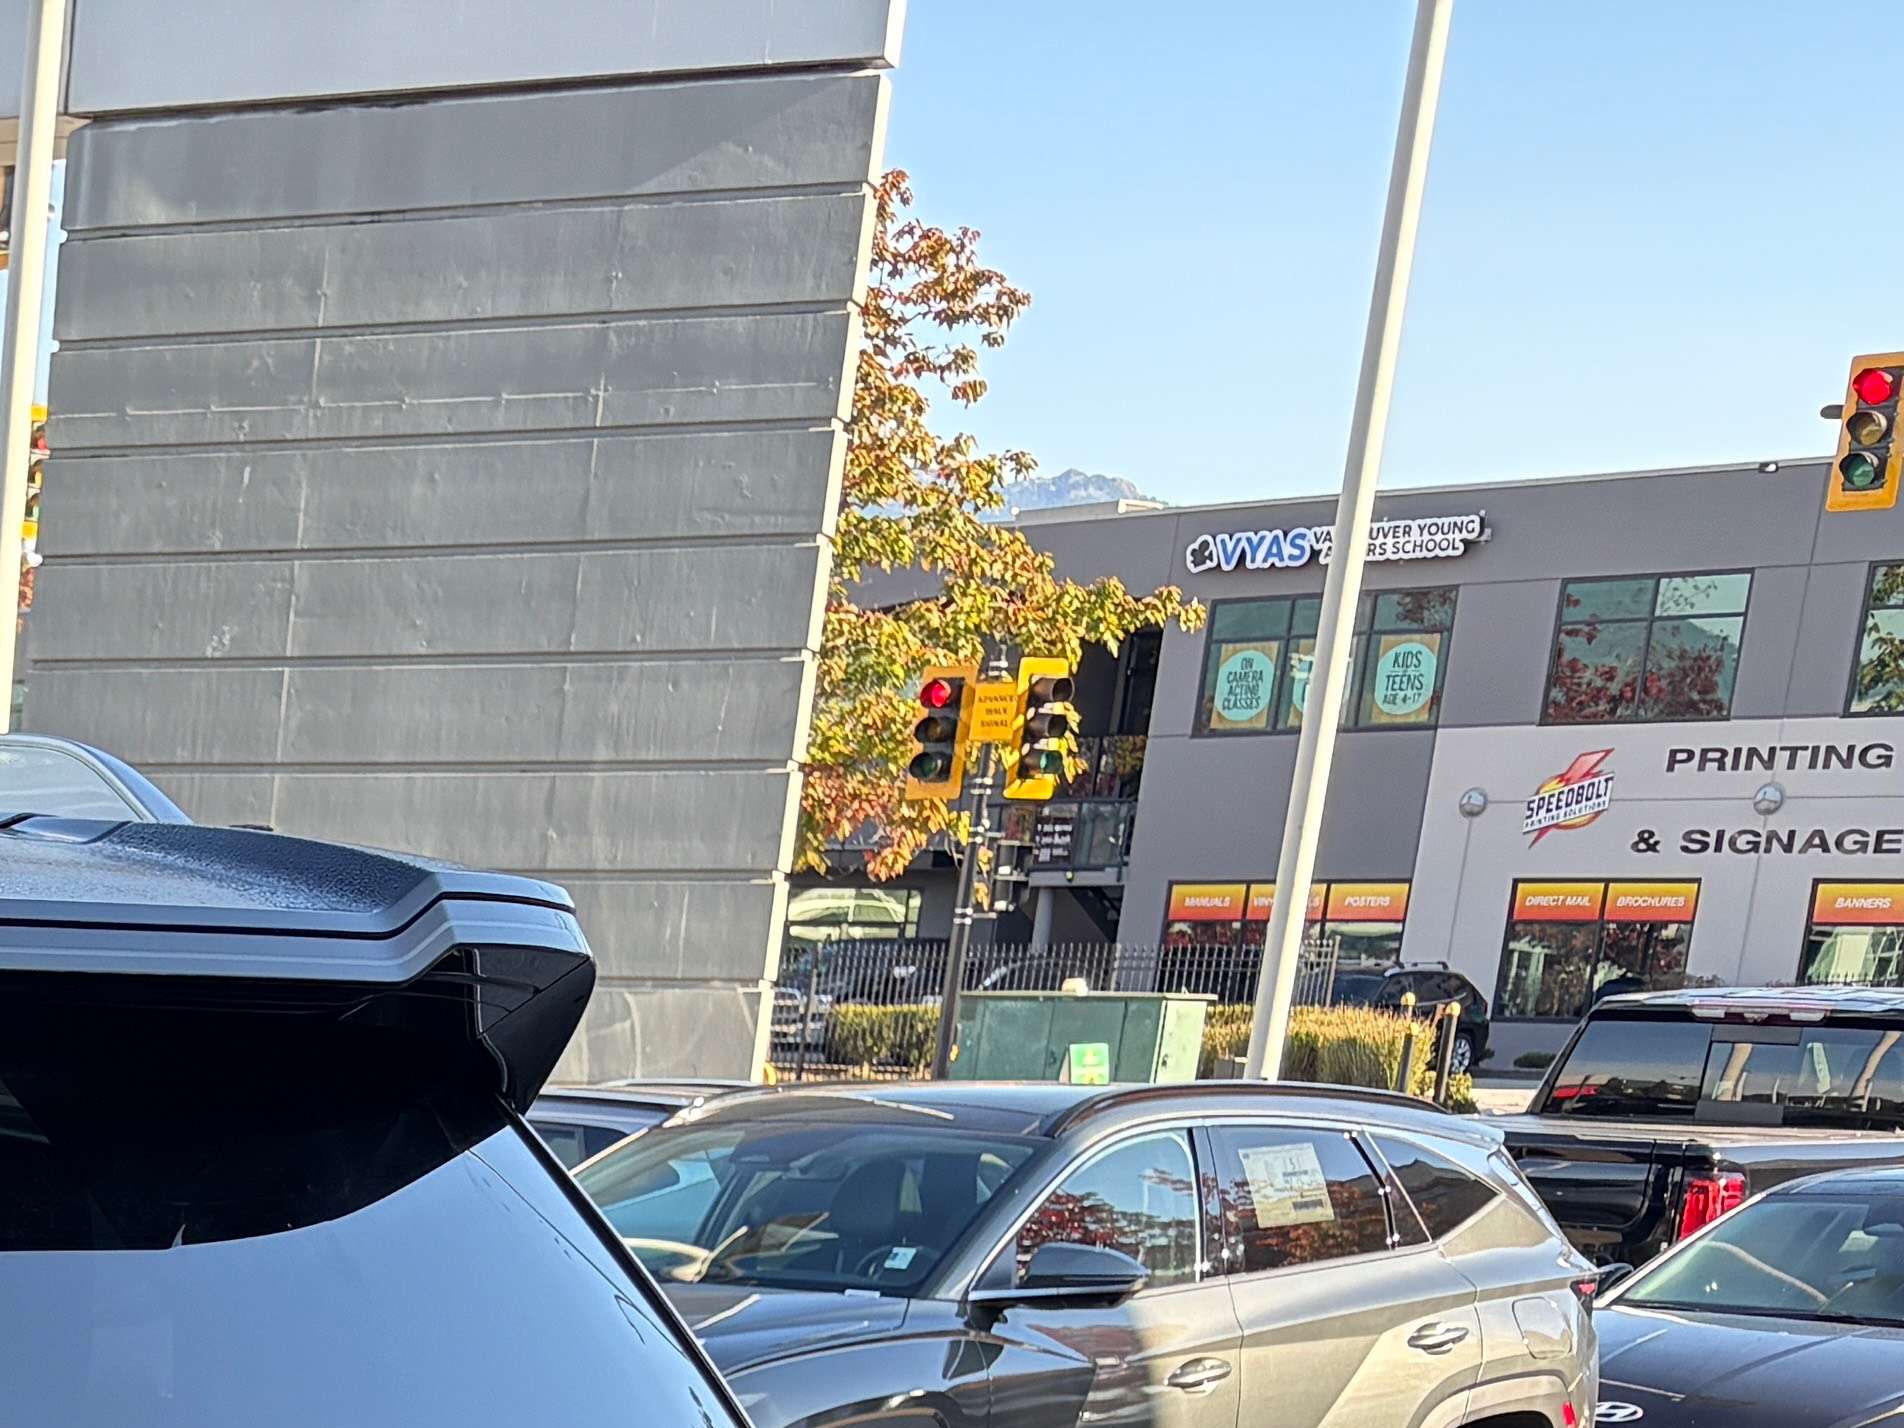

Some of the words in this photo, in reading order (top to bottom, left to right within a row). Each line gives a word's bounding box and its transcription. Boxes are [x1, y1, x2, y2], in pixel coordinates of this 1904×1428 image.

[1313, 523, 1412, 545] VAUVER
[1417, 519, 1476, 537] YOUNG
[1220, 530, 1308, 566] VYAS
[1391, 537, 1460, 555] SCHOOL
[1392, 650, 1423, 669] KIDS
[1226, 669, 1264, 684] CAMERA
[1385, 673, 1424, 692] TEENS
[1227, 683, 1260, 697] ACTING
[1222, 696, 1261, 710] CLASSES
[1665, 743, 1895, 772] PRINTING
[1524, 776, 1615, 820] SPEEDBOLT
[1630, 829, 1661, 853] &
[1679, 829, 1904, 855] SIGNAGE
[1184, 896, 1231, 907] MANUALS
[1344, 896, 1391, 907] POSTERS
[1525, 896, 1564, 907] DIRECT
[1565, 895, 1592, 907] MAIL
[1616, 895, 1686, 908] BROCHURES
[1834, 897, 1892, 909] BANNERS
